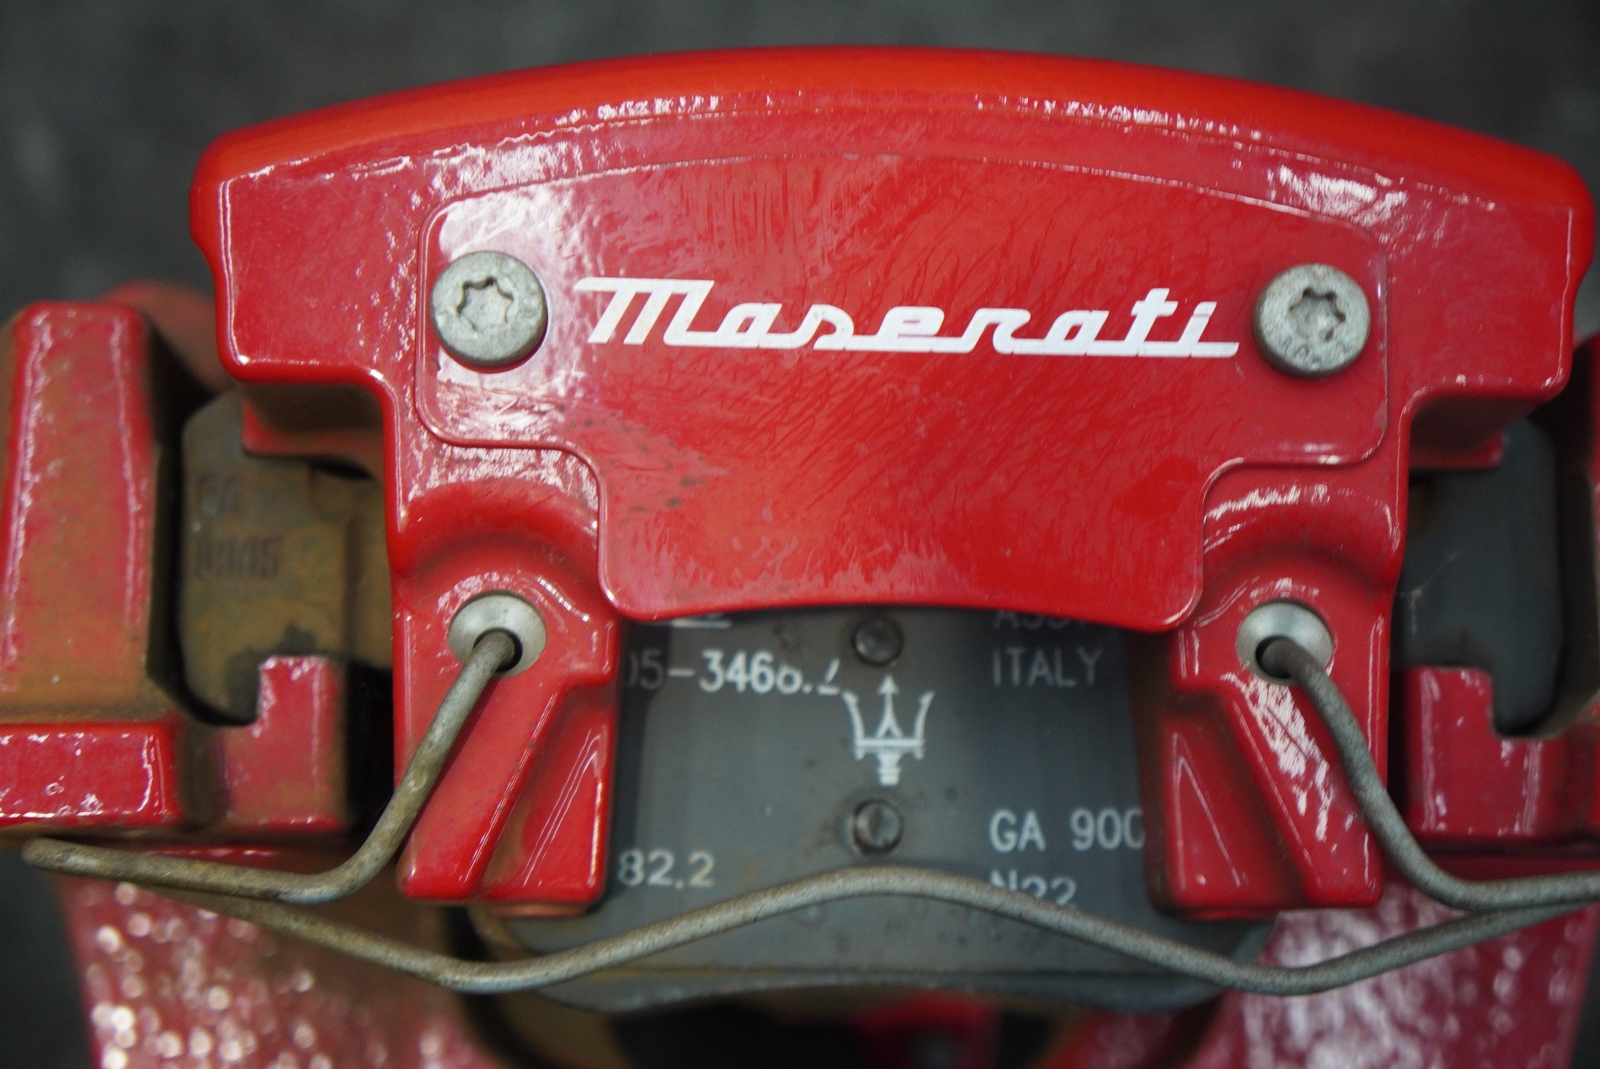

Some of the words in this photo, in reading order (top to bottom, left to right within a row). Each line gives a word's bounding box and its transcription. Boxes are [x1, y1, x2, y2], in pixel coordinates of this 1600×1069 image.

[573, 276, 1241, 358] Maserati
[991, 646, 1105, 688] ITALY
[989, 809, 1046, 852] GA
[617, 848, 716, 889] 82.2
